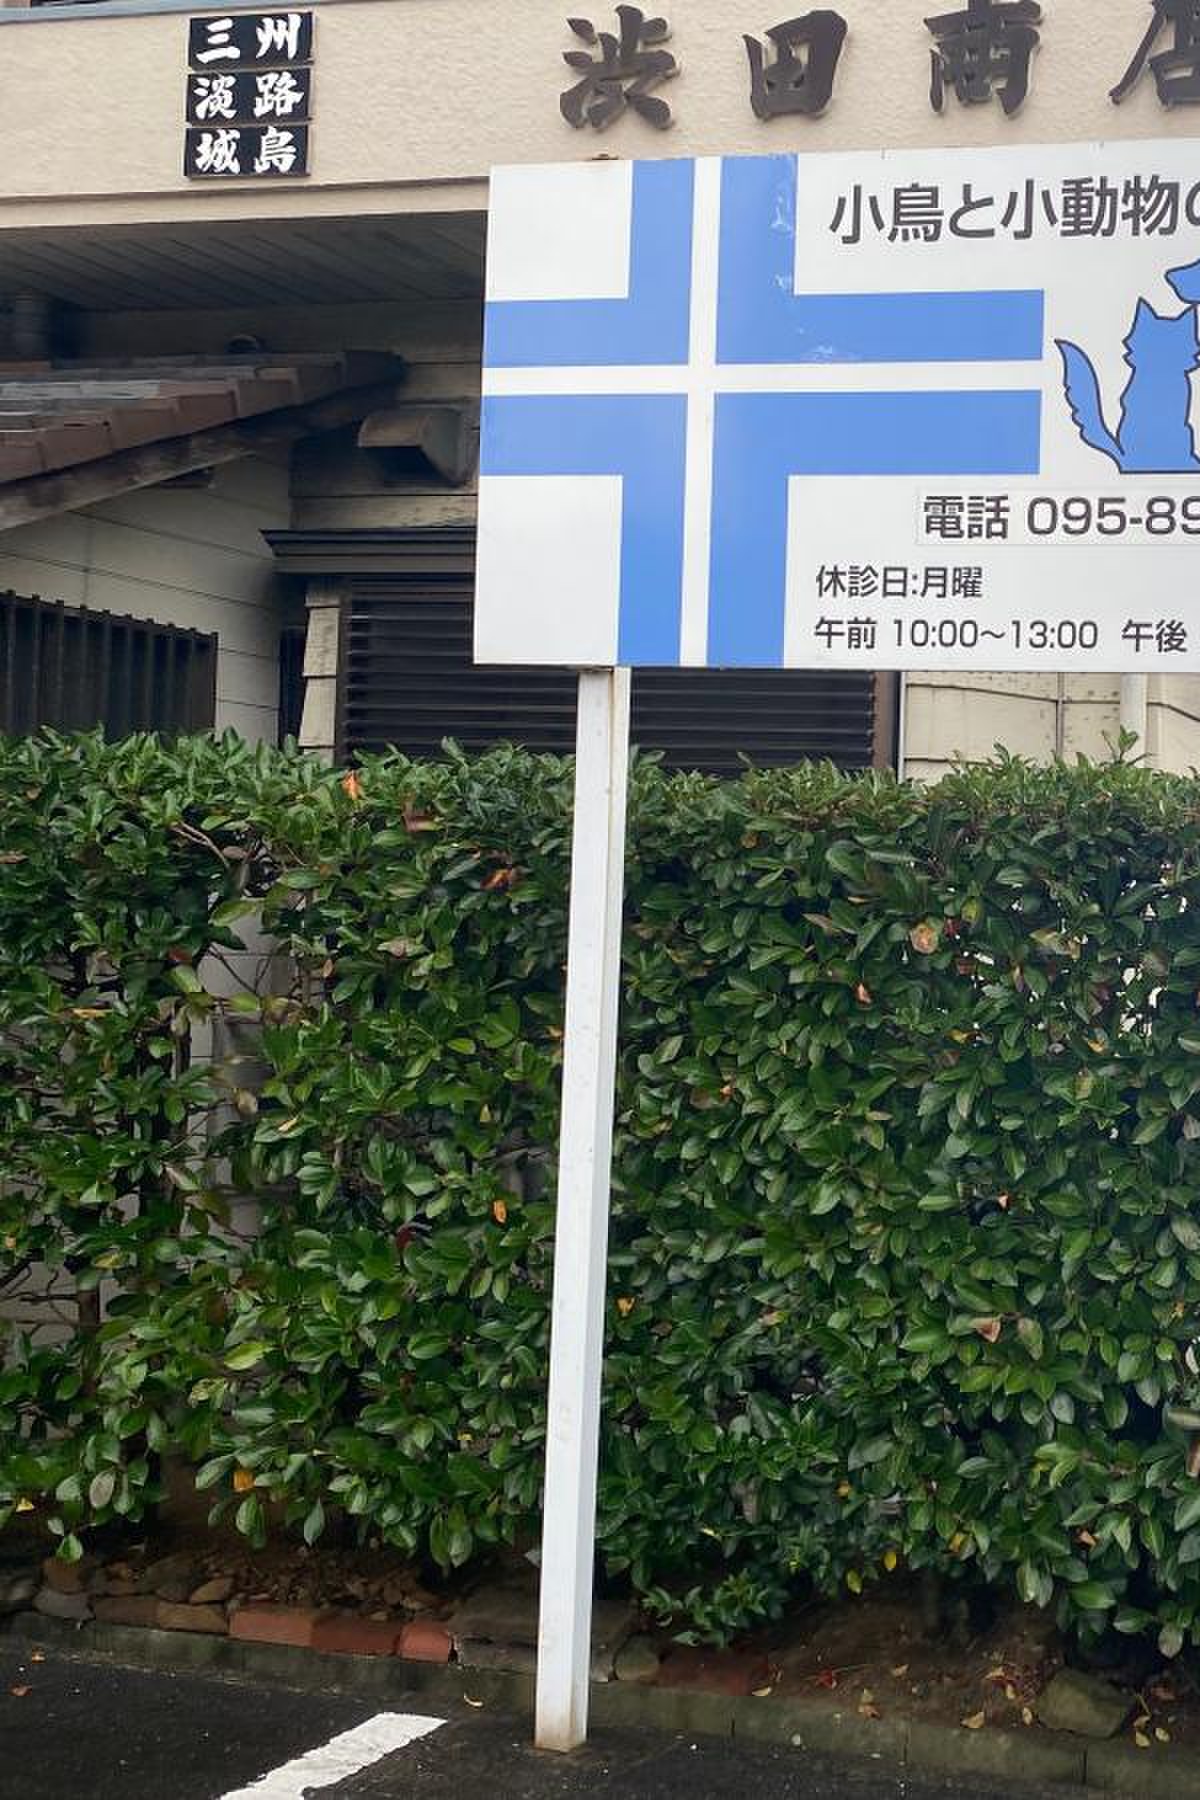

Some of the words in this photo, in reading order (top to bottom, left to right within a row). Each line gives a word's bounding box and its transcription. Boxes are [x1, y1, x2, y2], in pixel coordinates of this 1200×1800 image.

[195, 13, 302, 64] 三州
[193, 71, 305, 120] 淡路
[923, 495, 1010, 540] 電話
[815, 565, 983, 599] 休診日:月曜
[814, 616, 877, 650] 午前
[1121, 618, 1187, 653] 午後
